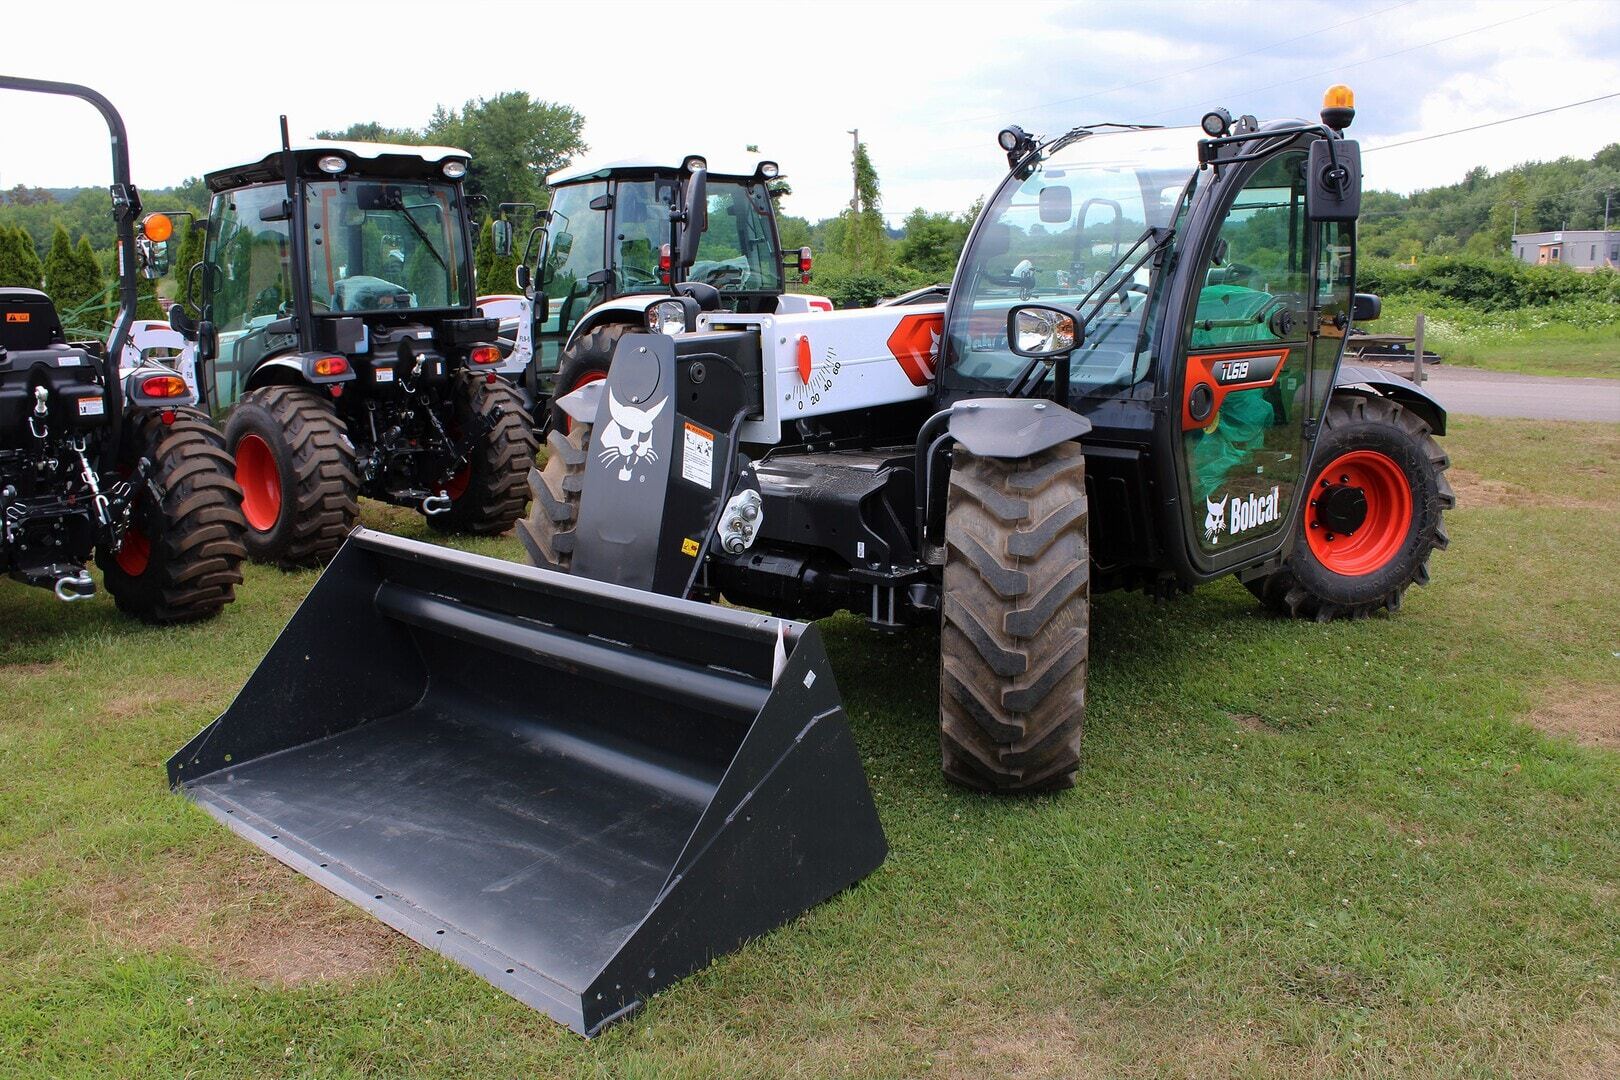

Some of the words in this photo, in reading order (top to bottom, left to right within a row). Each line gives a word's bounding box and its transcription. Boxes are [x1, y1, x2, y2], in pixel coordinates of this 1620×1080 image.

[798, 401, 803, 410] 0
[811, 393, 820, 405] 20
[824, 380, 832, 392] 40
[833, 362, 841, 375] 60
[1221, 361, 1250, 380] TL619
[1230, 486, 1280, 535] Bobcat
